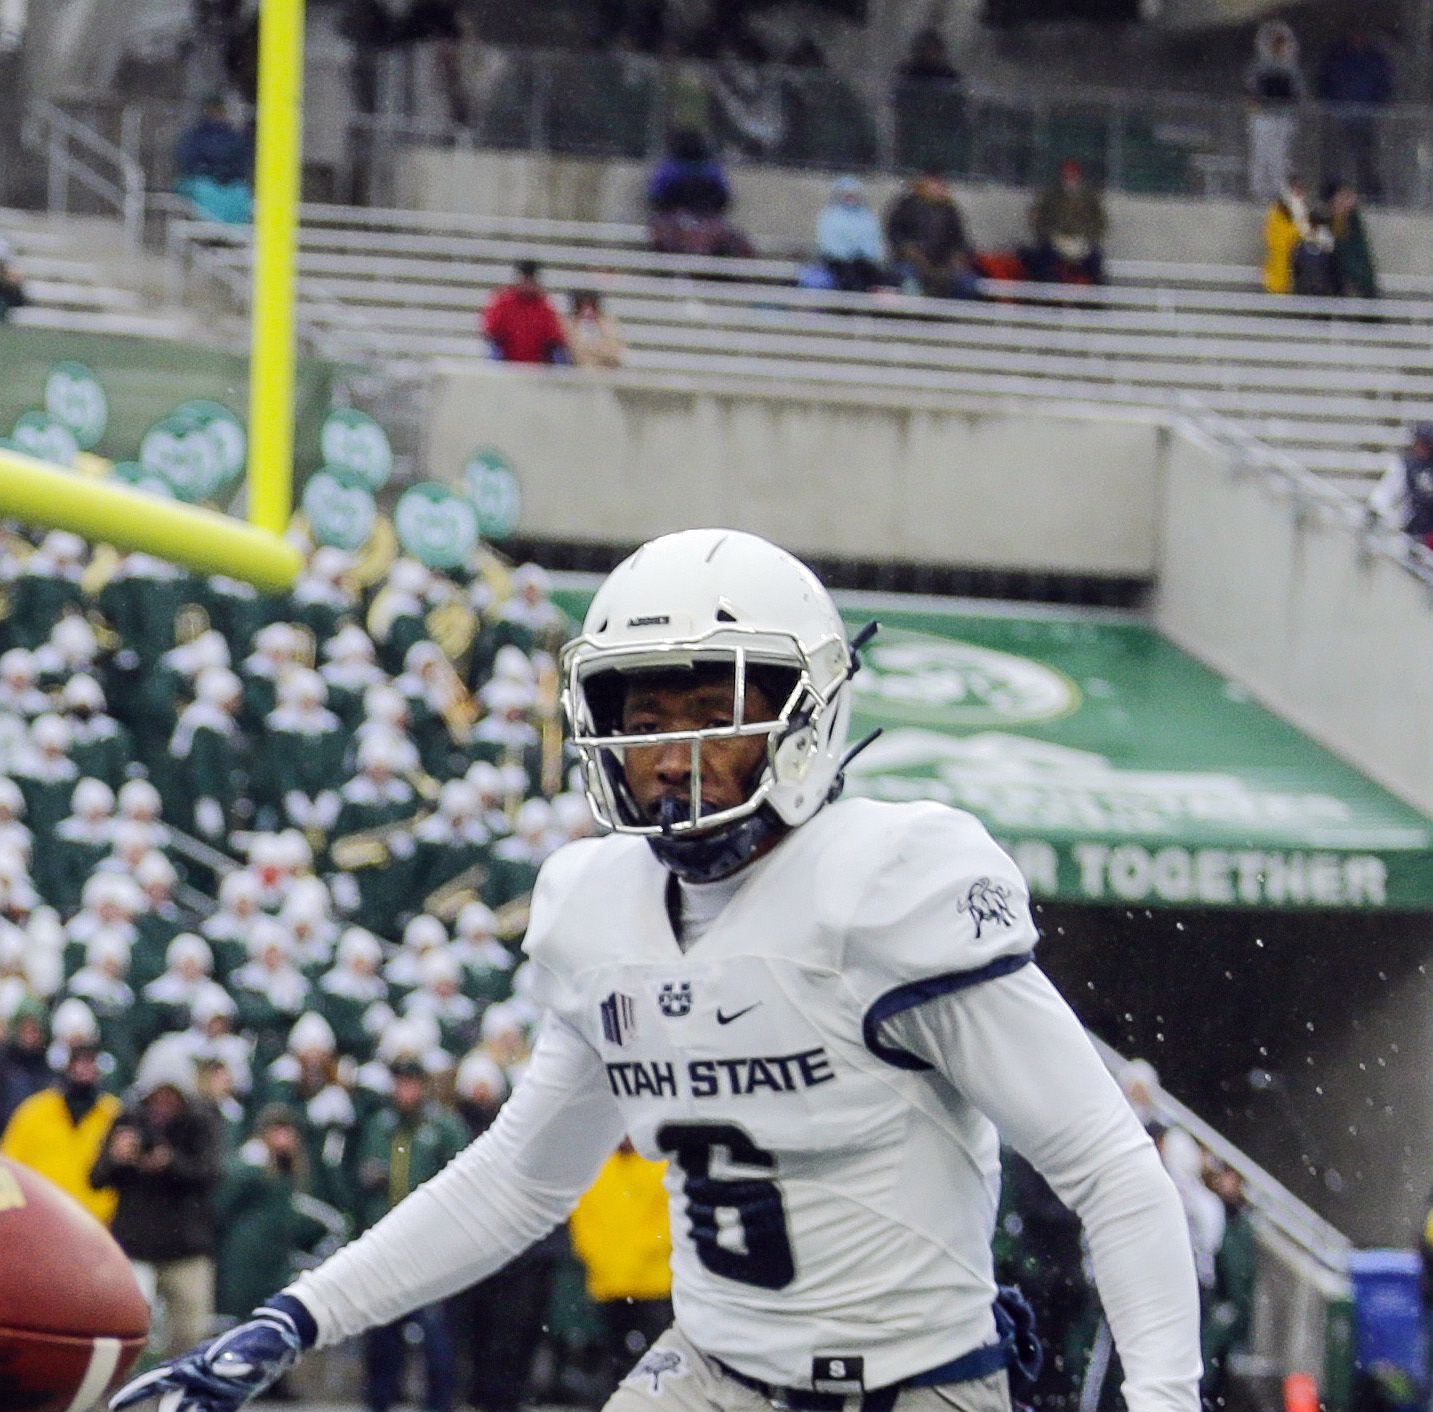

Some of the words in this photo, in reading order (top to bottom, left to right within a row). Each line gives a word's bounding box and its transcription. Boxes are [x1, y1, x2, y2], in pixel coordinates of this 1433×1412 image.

[1072, 843, 1388, 907] TOGETHER
[688, 1047, 835, 1097] STATE
[656, 1120, 795, 1291] 6
